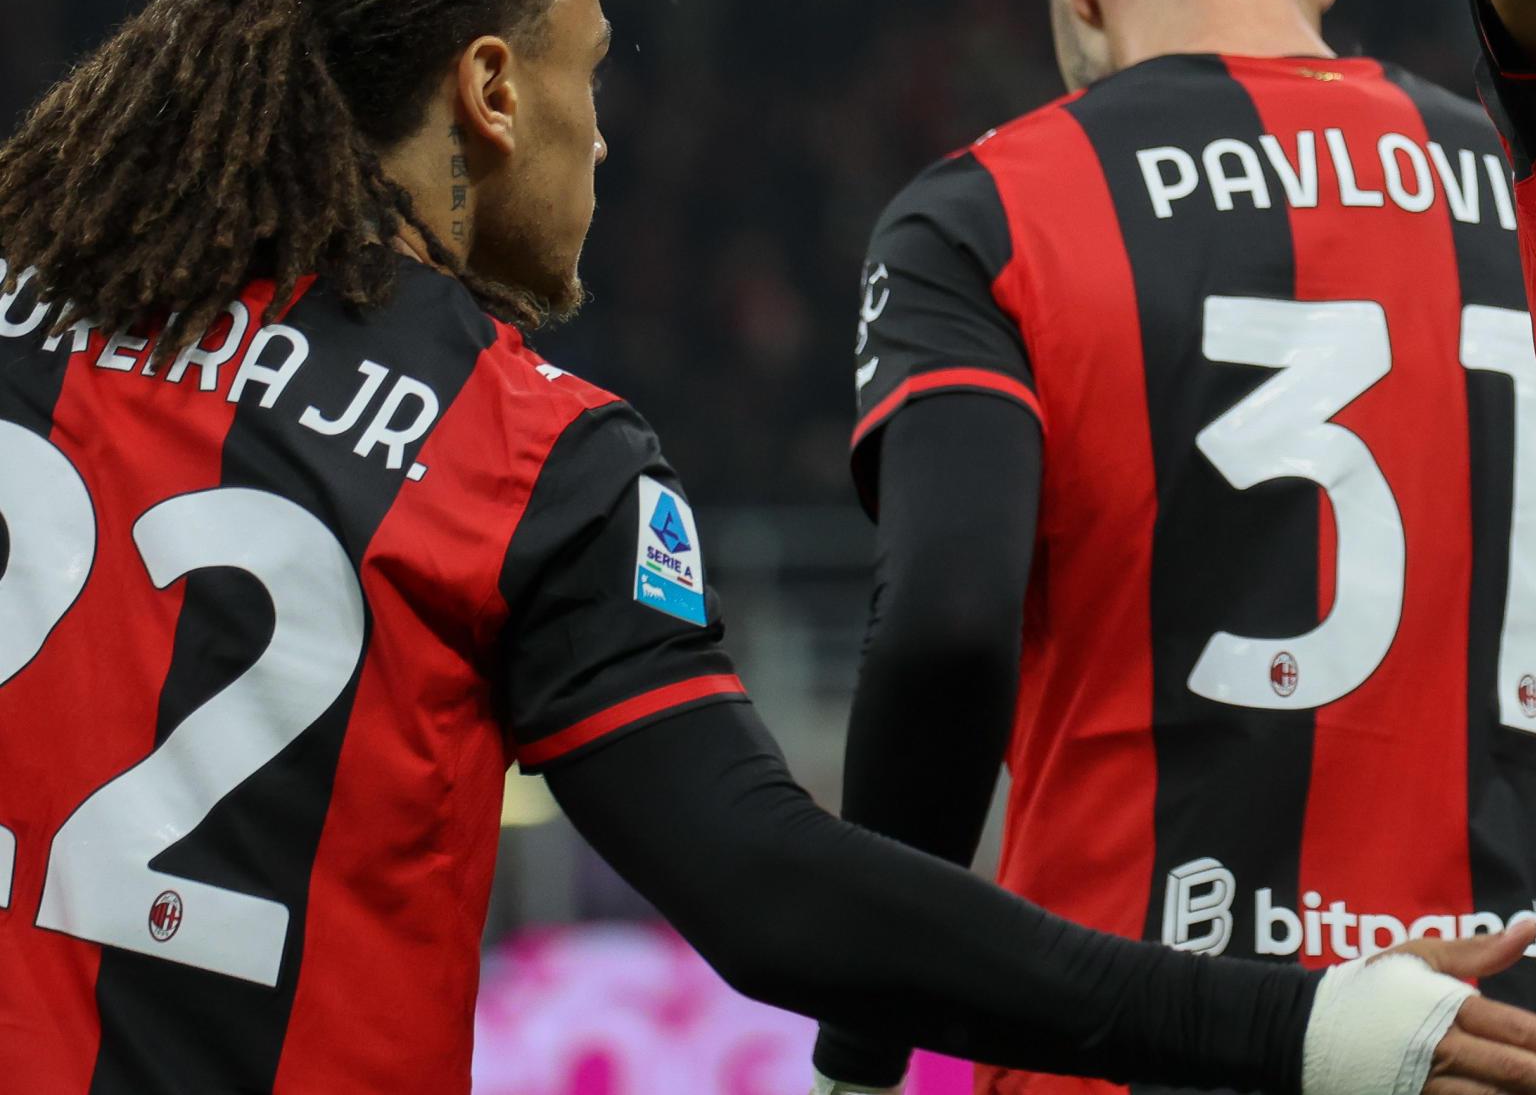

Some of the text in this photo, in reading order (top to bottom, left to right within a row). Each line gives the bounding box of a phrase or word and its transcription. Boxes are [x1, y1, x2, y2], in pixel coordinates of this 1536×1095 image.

[299, 359, 440, 483] JR.
[646, 545, 694, 580] SERIE A
